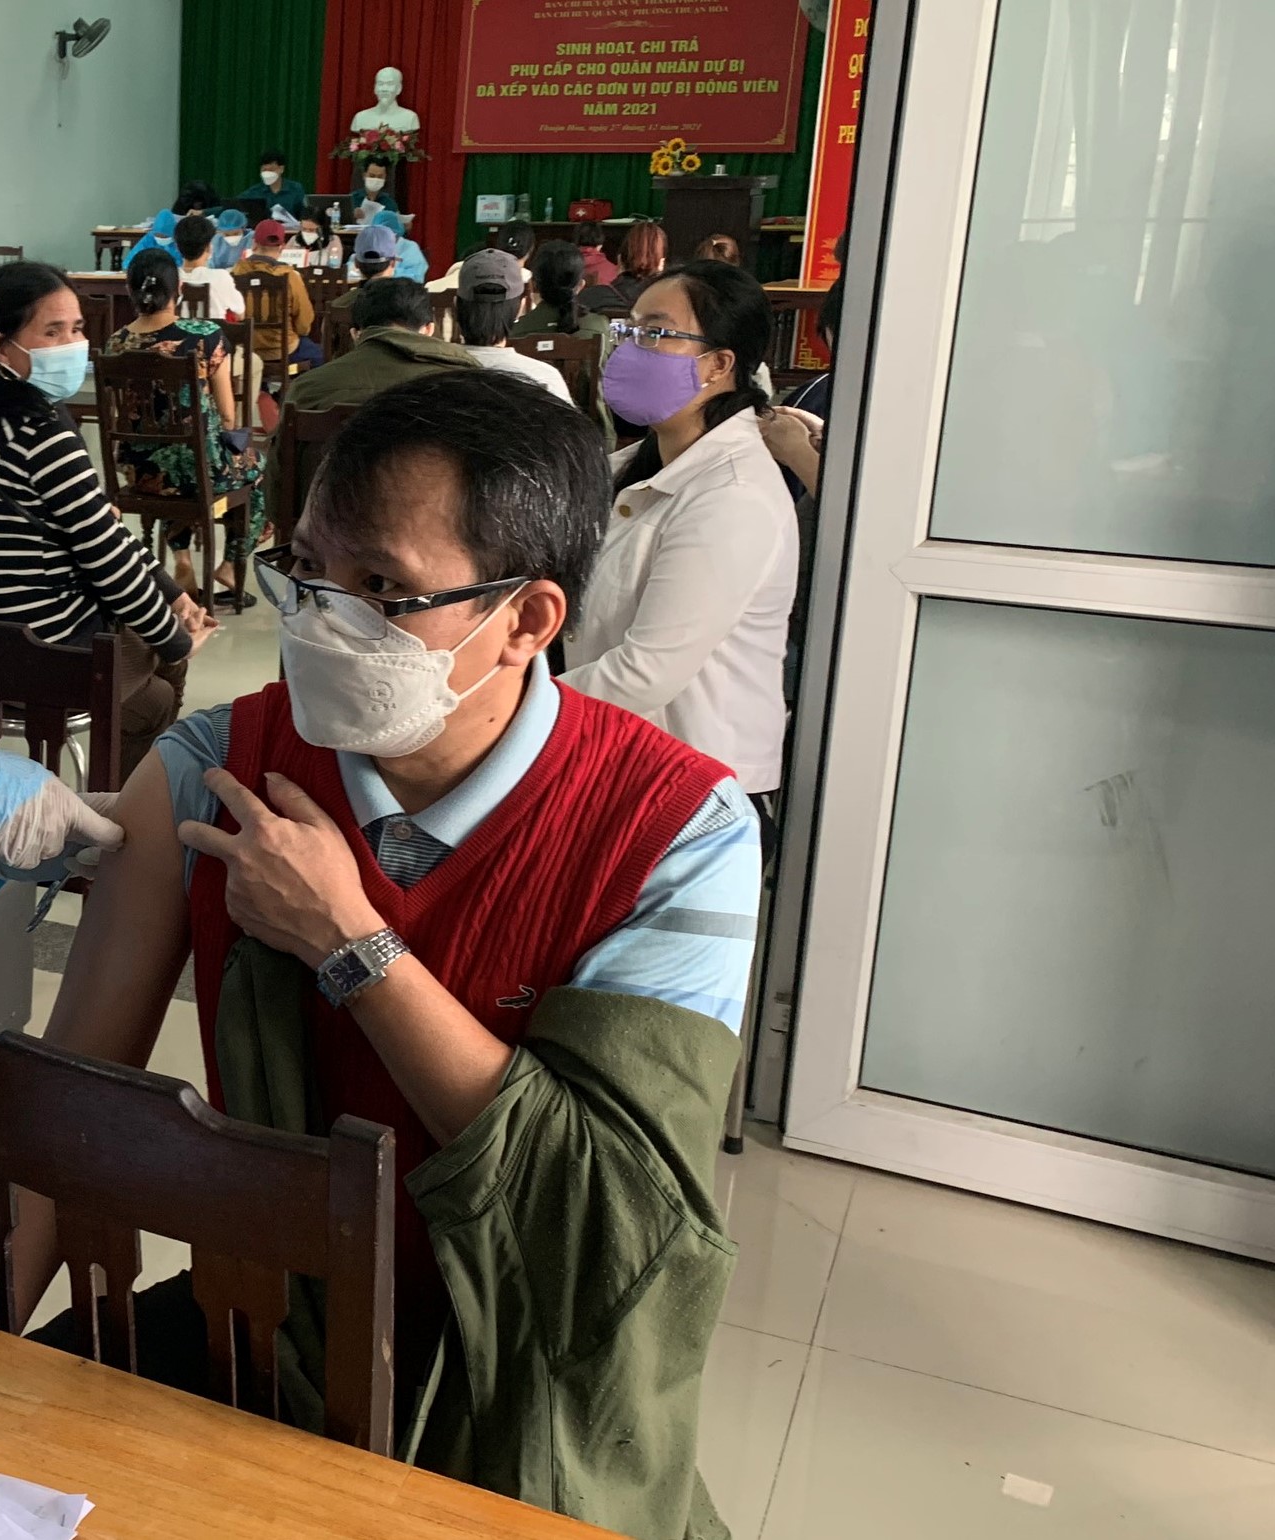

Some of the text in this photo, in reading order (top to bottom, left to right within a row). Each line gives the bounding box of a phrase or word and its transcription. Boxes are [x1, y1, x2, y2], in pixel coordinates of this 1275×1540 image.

[556, 43, 591, 55] SINH
[640, 40, 666, 53] CHI
[670, 35, 699, 52] TRẢ
[510, 58, 745, 79] PHỤ CẤP CHO QUÂN NHÂN DỰ BỊ
[476, 77, 780, 97] ĐÃ XẾP VÀO CÁC ĐƠN VỊ DỰ BỊ ĐỘNG VIÊN
[583, 101, 657, 116] NĂM 2021
